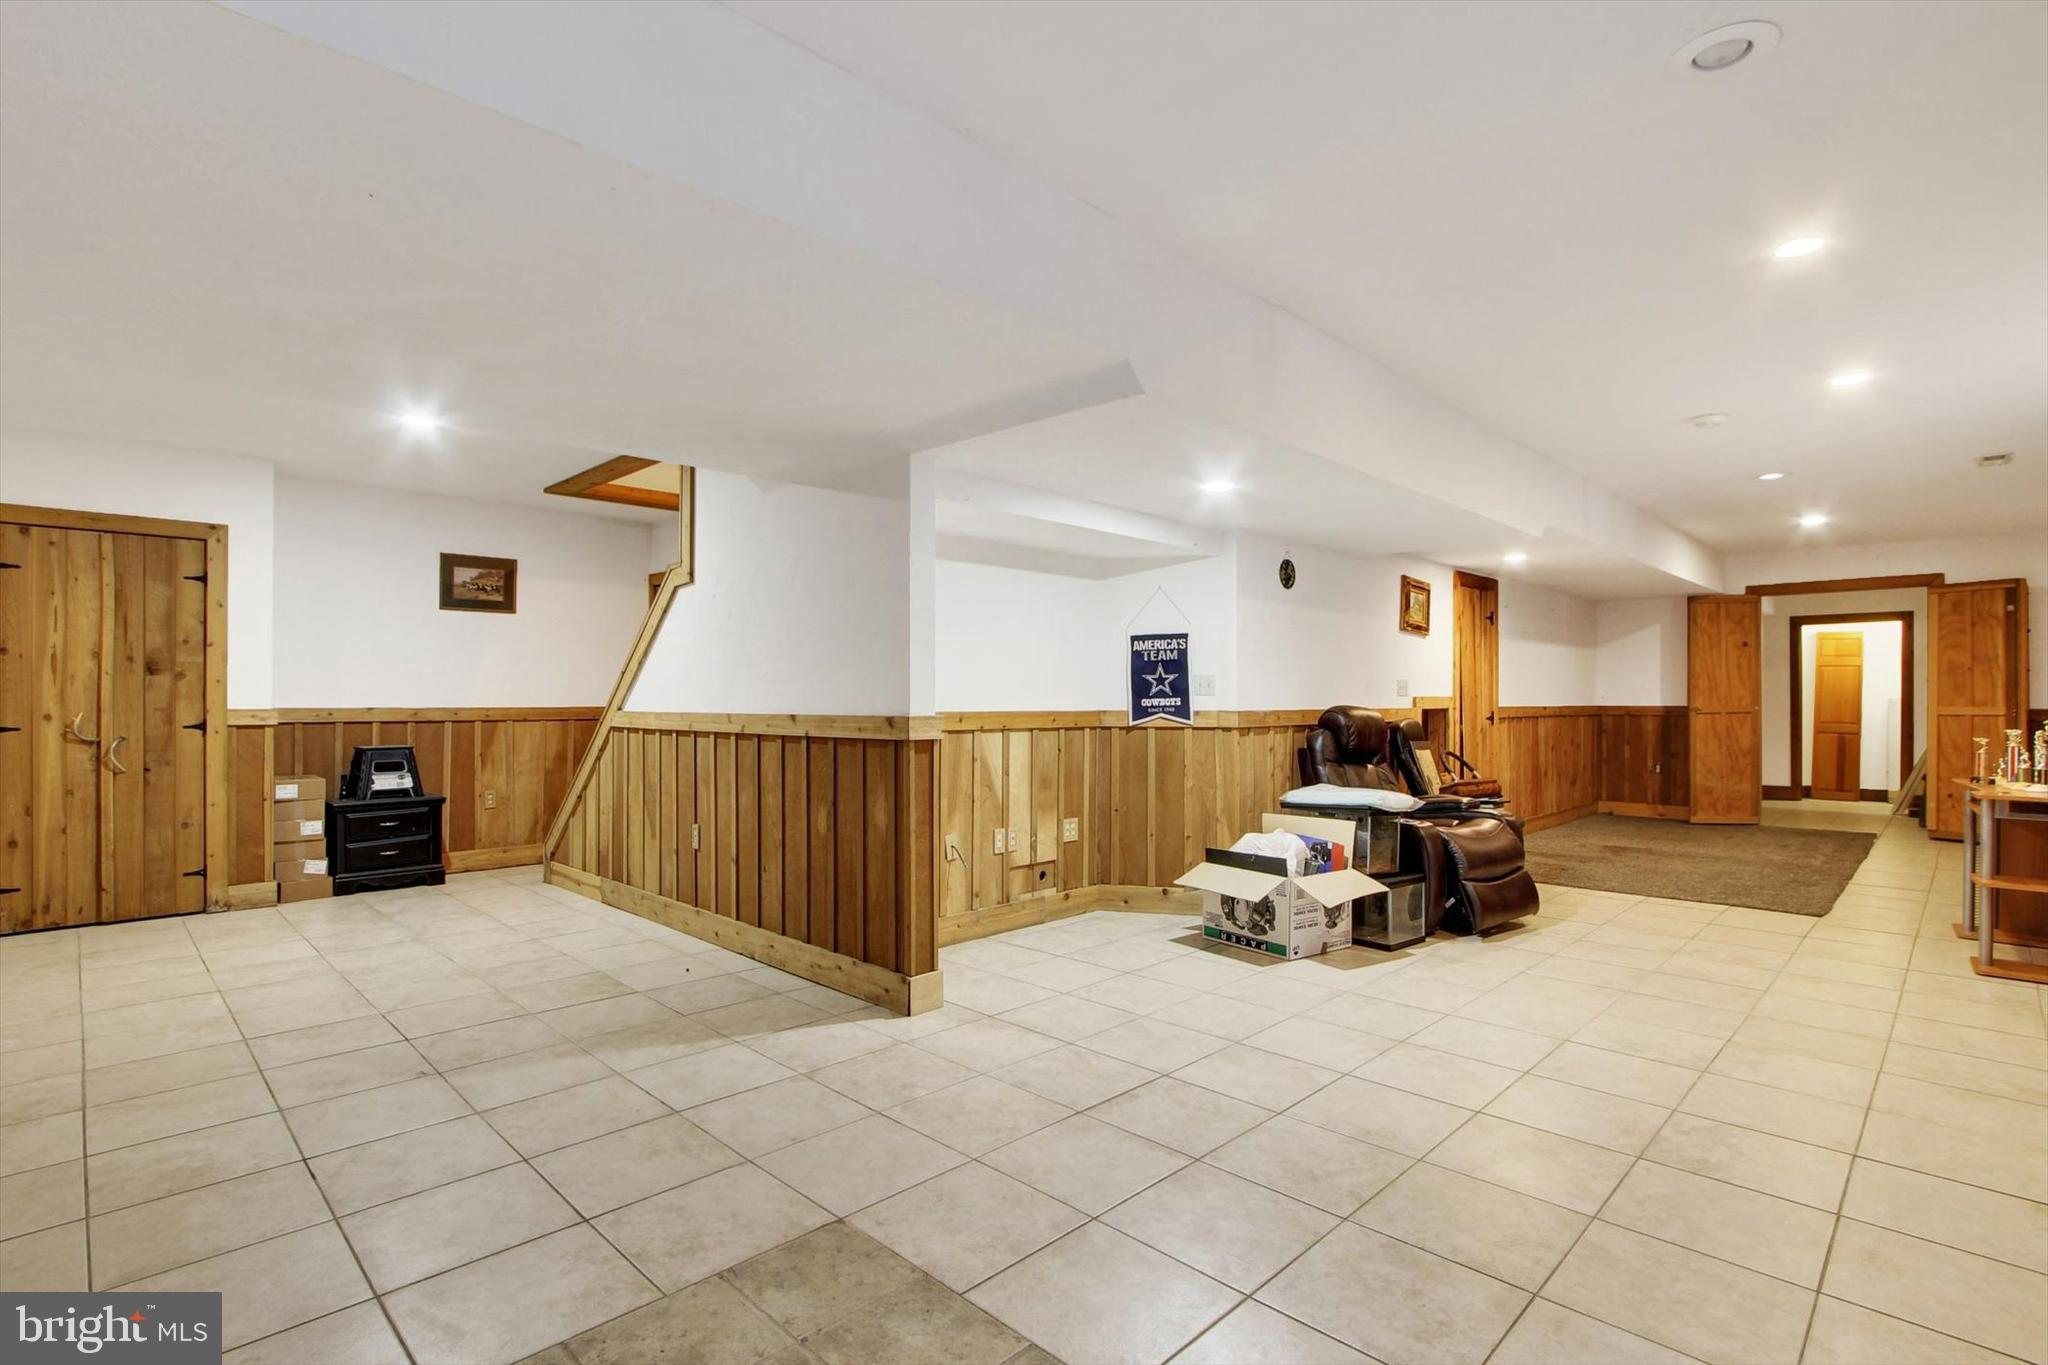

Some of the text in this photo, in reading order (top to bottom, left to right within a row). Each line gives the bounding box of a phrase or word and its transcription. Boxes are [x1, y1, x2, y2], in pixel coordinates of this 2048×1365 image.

[1133, 638, 1186, 651] AMERICA'S
[1141, 650, 1178, 661] TEAM
[1141, 697, 1181, 707] COWBOYS
[1220, 932, 1267, 950] PACER
